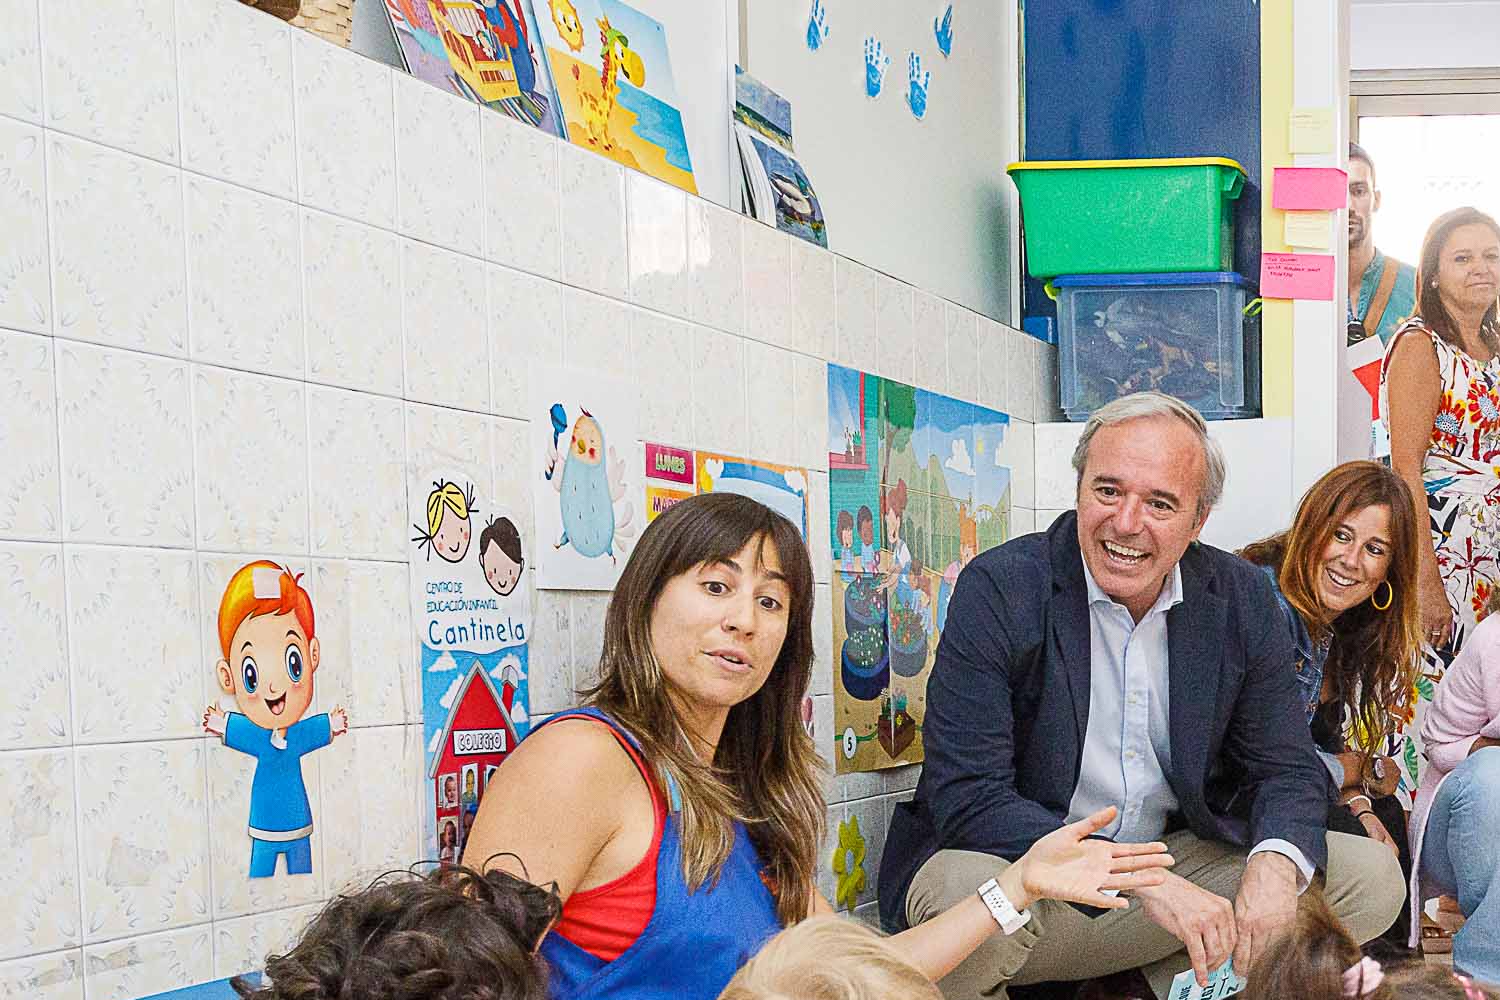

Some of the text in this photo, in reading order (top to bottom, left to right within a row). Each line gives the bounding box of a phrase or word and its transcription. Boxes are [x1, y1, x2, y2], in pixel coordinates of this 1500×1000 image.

[655, 453, 686, 475] LUNES
[426, 581, 463, 595] CENTRO DE
[428, 616, 525, 645] Cantinela
[458, 732, 502, 751] COLEGIO
[847, 736, 853, 752] 5
